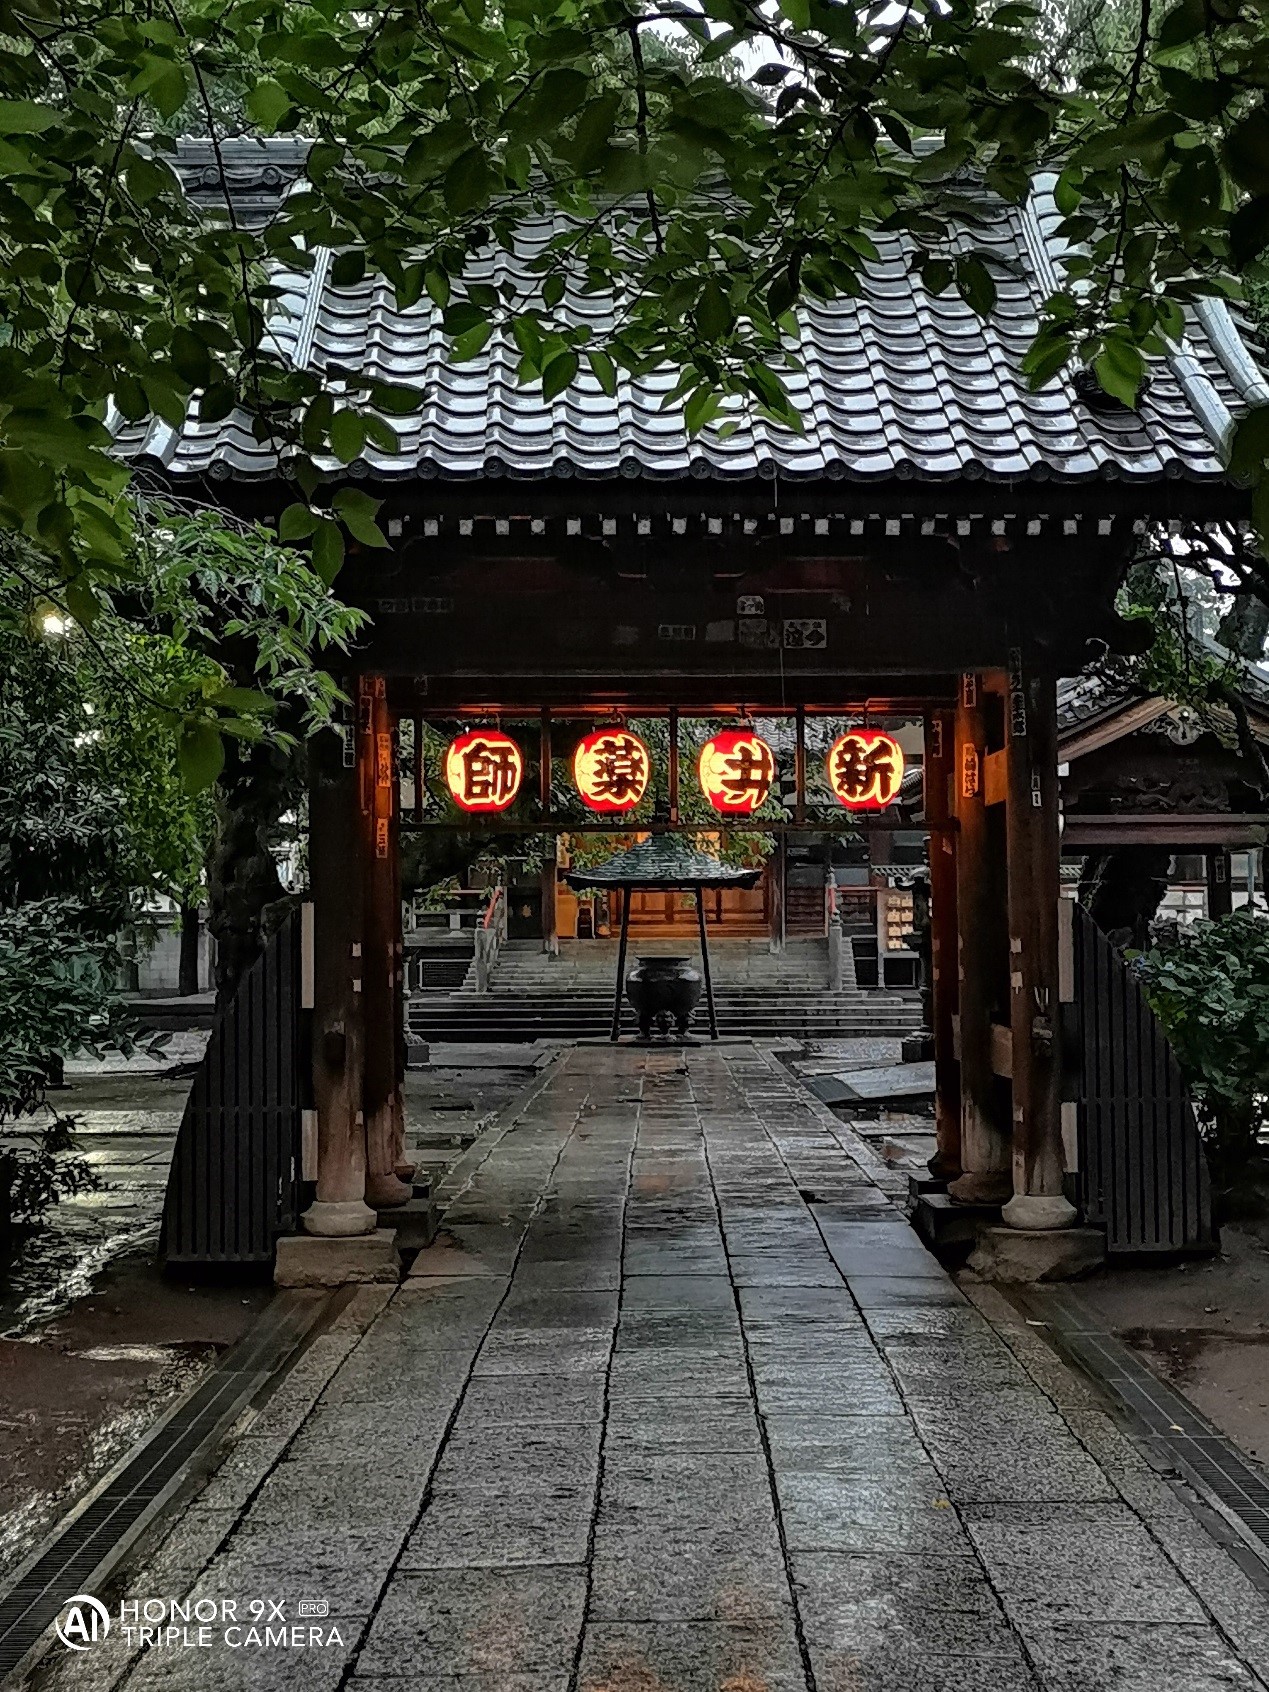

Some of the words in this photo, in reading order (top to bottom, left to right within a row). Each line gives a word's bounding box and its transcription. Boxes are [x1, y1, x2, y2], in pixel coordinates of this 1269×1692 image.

[462, 741, 517, 802] 師
[720, 741, 773, 805] 井
[836, 737, 895, 801] 新
